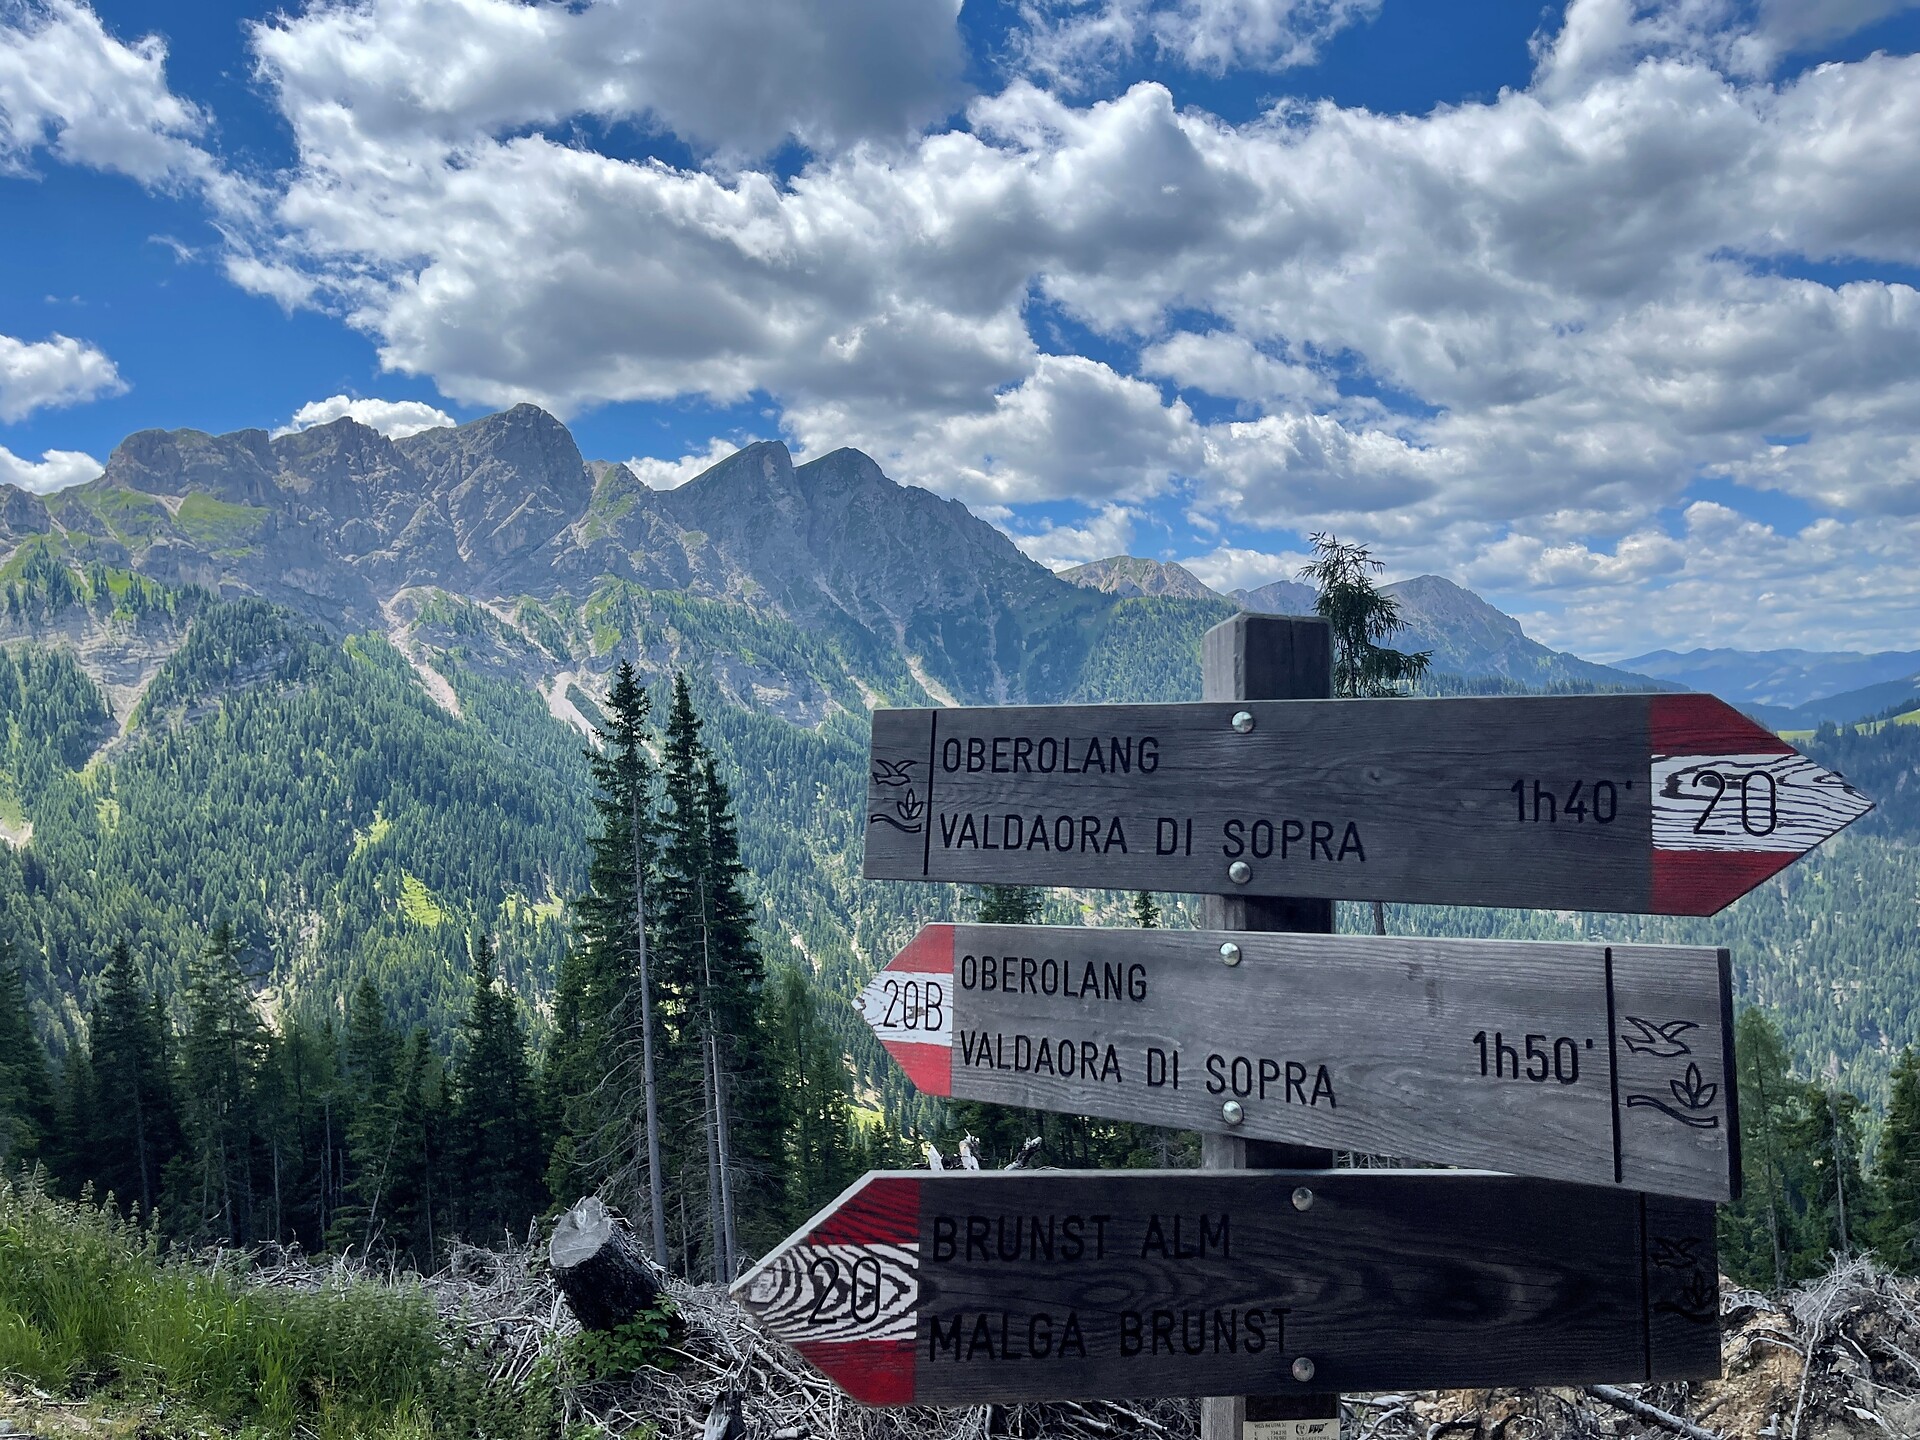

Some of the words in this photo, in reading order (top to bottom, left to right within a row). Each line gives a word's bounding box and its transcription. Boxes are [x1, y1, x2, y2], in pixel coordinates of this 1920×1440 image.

[942, 736, 1160, 774] OBEROLANG
[1691, 769, 1778, 837] 20
[939, 813, 1128, 854] VALDAORA
[1156, 817, 1193, 856] DI
[1222, 819, 1366, 862] SOPRA
[961, 955, 1147, 1001] OBEROLANG
[882, 979, 943, 1031] 20B
[960, 1030, 1122, 1083] VALDAORA
[1146, 1047, 1179, 1090] DI
[1205, 1054, 1337, 1109] SOPRA
[933, 1214, 1111, 1262] BRUNST
[1141, 1214, 1231, 1259] ALM
[808, 1256, 882, 1324] 20
[928, 1313, 1086, 1363] MALGA
[1119, 1308, 1292, 1358] BRUNST
